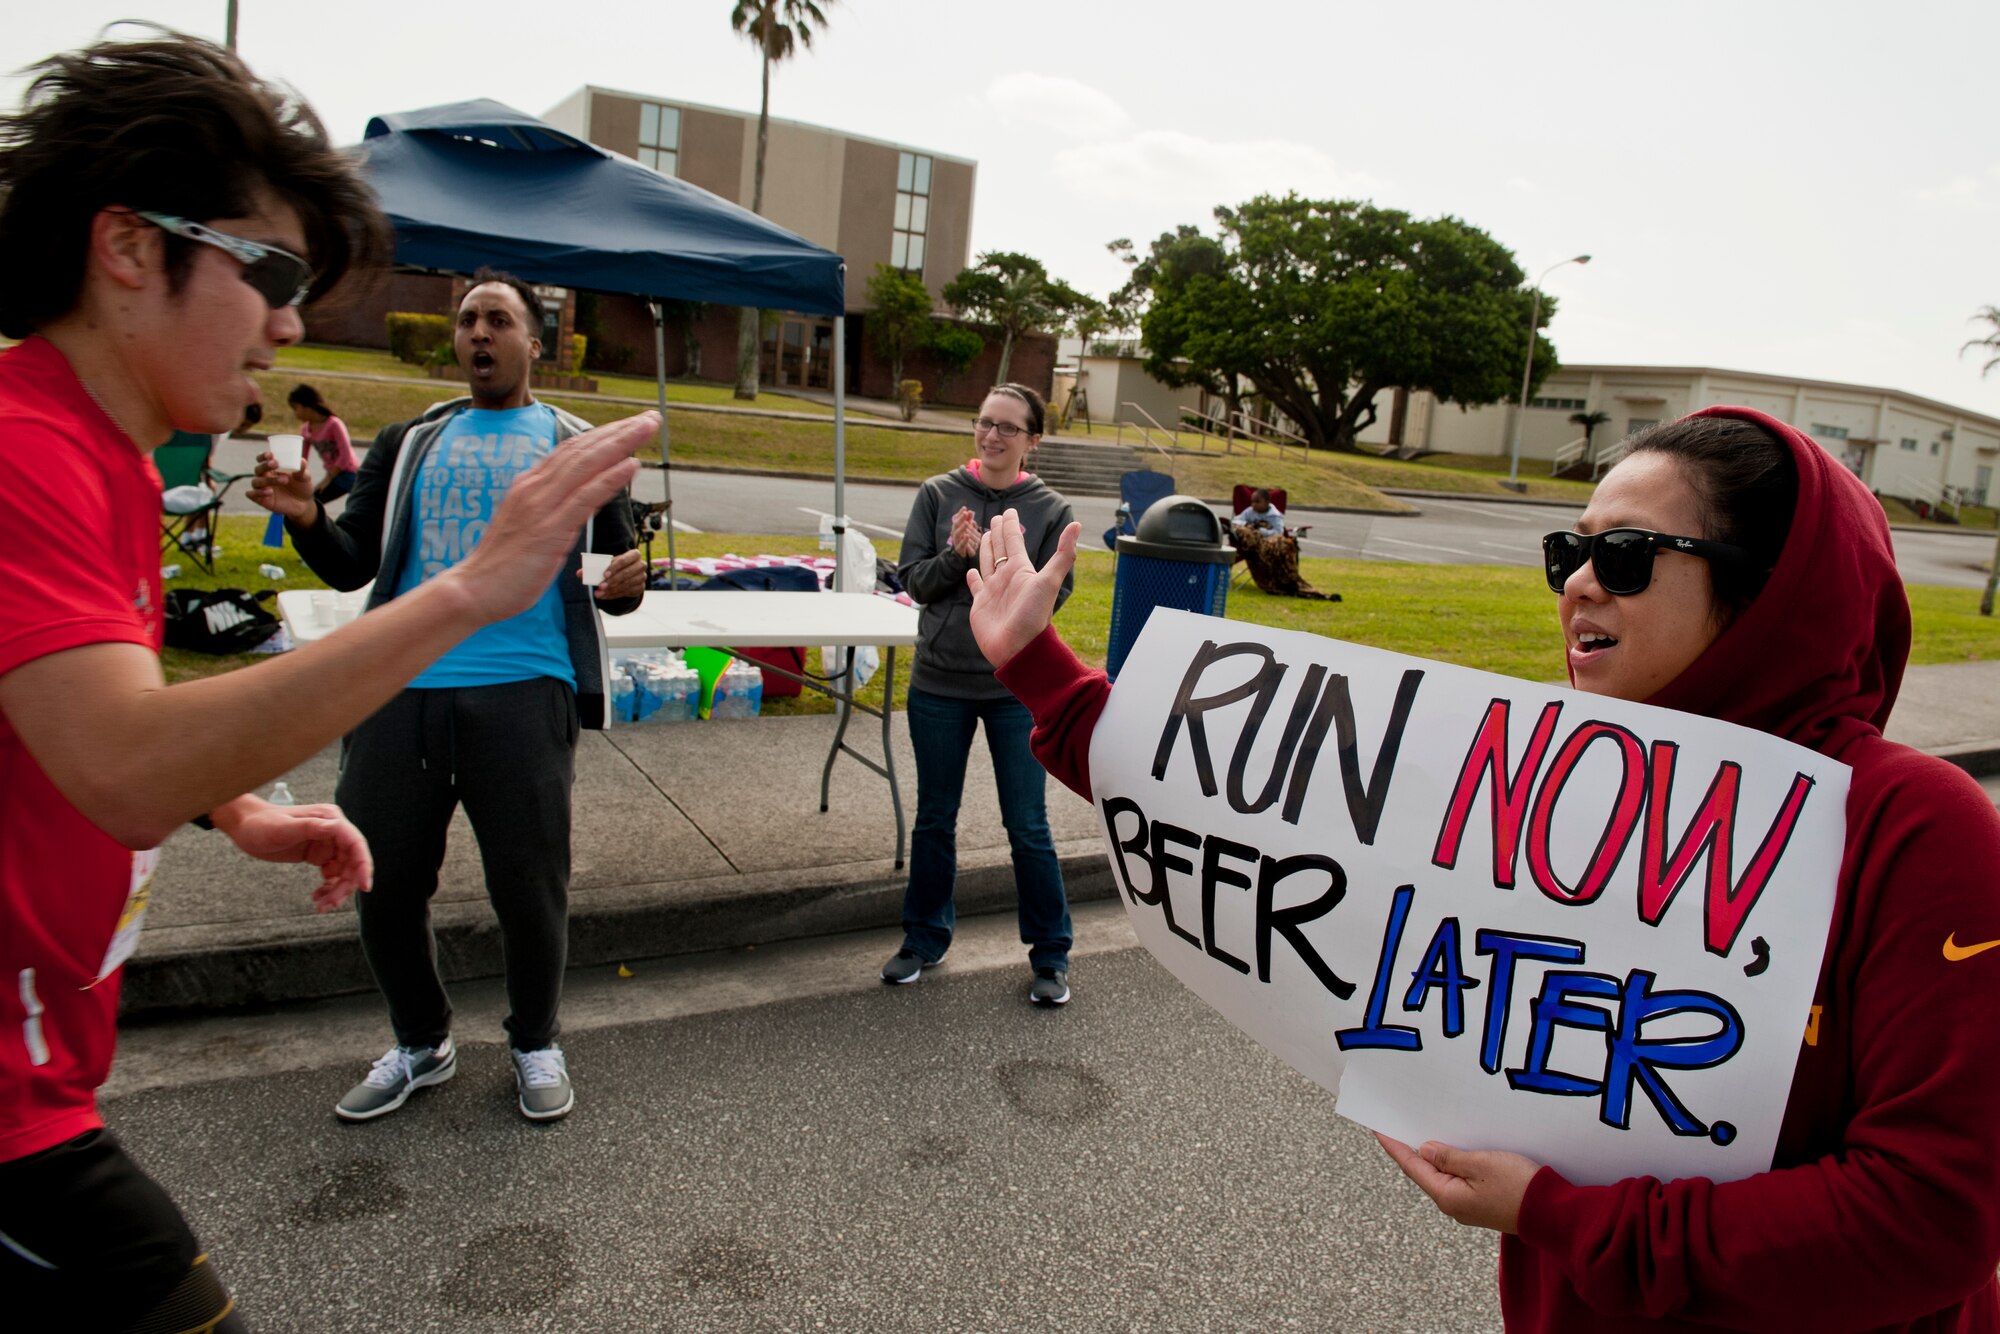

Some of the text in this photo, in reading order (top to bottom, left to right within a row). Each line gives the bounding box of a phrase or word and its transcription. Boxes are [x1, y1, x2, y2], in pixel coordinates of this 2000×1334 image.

[447, 433, 551, 468] RUN
[422, 468, 449, 488] TO
[453, 468, 487, 489] SEE
[419, 488, 482, 520] HAS
[1152, 640, 1816, 977] RUN NOW,
[1102, 796, 1745, 1146] BEER LATER.
